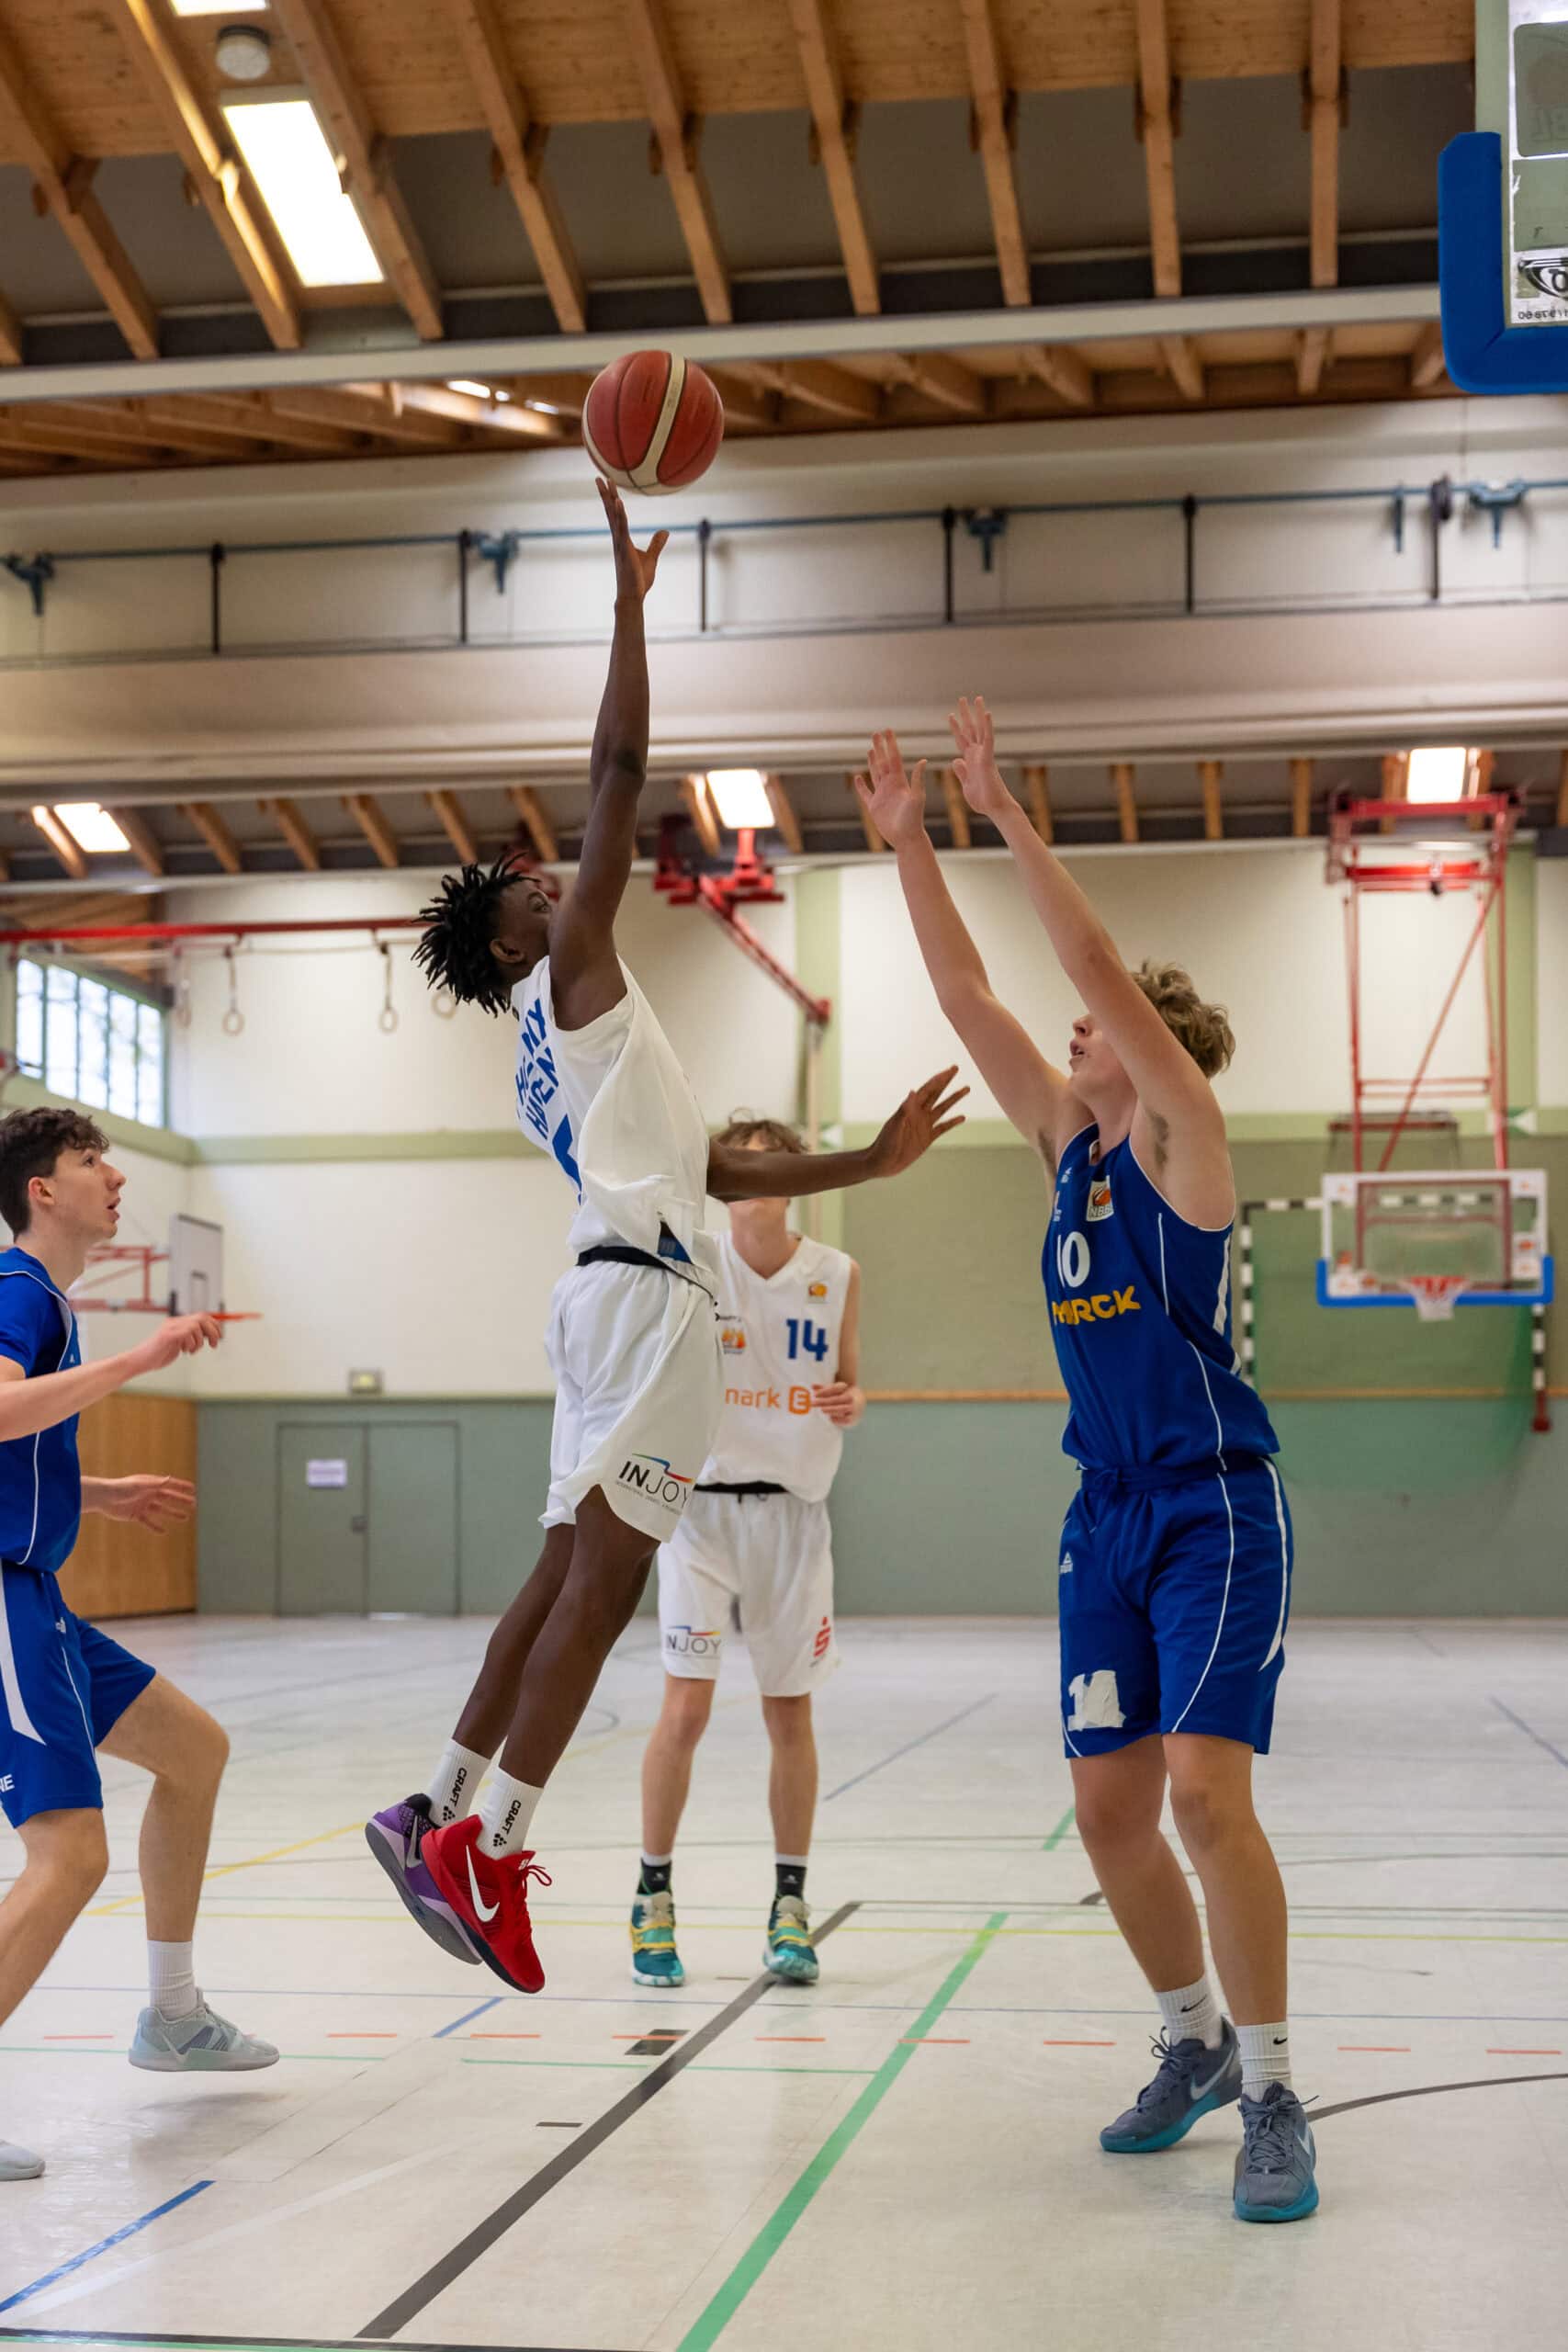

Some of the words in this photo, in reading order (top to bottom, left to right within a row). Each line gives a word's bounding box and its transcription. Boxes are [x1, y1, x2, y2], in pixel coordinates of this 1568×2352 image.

[1056, 1230, 1091, 1288] 10
[785, 1318, 829, 1363] 14
[449, 1767, 468, 1807] CRAFT
[502, 1799, 522, 1835] CRAFT
